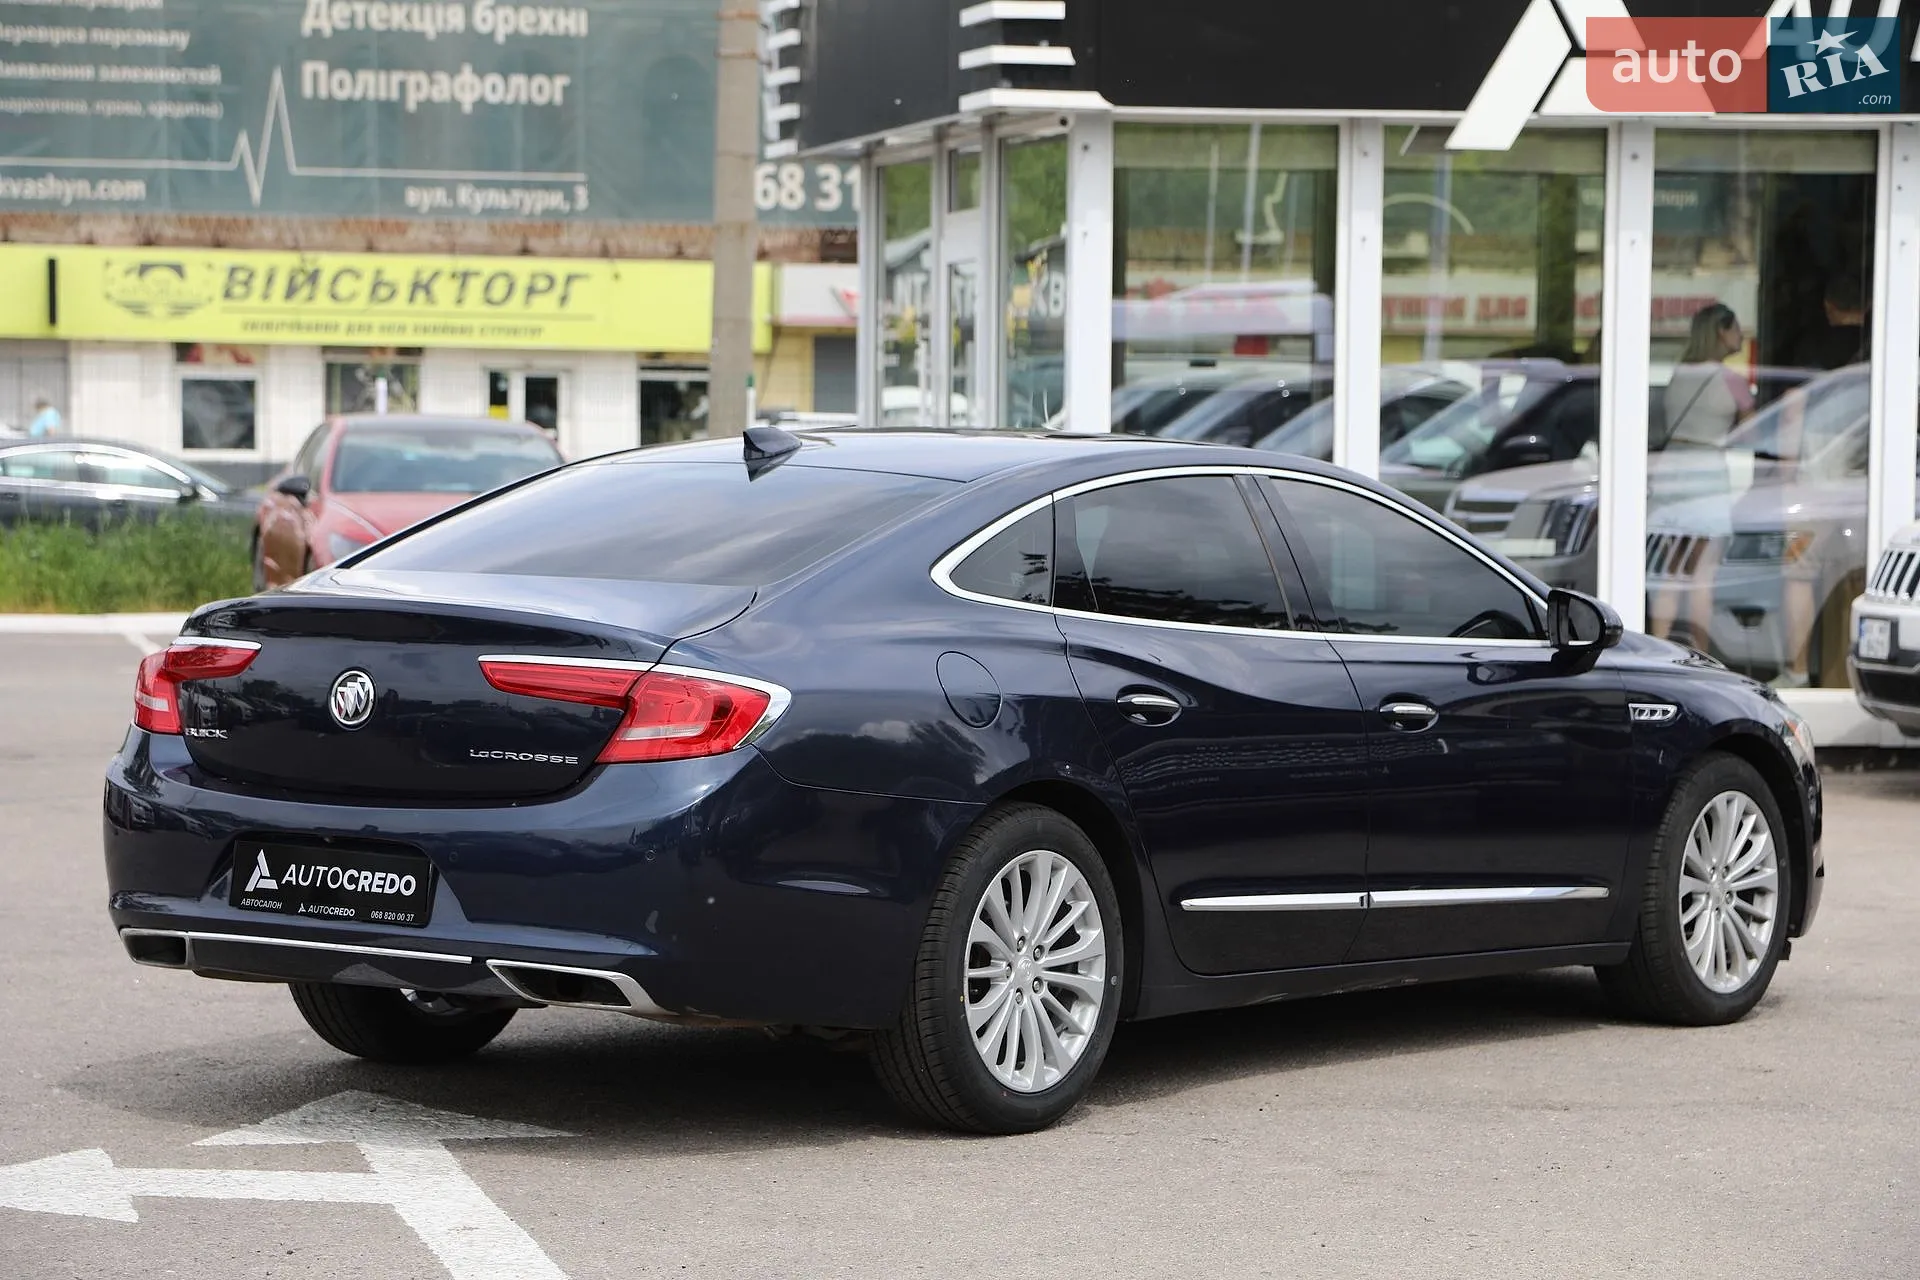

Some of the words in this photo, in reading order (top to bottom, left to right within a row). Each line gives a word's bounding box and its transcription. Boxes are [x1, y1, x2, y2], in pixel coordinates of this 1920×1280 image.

[302, 0, 464, 40] Детекція
[472, 0, 588, 43] брехні
[302, 60, 571, 114] Поліграфолог
[405, 186, 454, 214] вул.
[223, 262, 592, 308] ВІЙСЬКТОРГ
[184, 727, 229, 739] BUICK
[281, 863, 417, 897] AUTOCREDO
[240, 898, 282, 910] АВТОСАЛОН
[307, 905, 356, 917] AUTOCREDO
[370, 910, 383, 920] 068
[384, 912, 396, 921] 820
[397, 913, 406, 922] 00
[406, 914, 415, 922] 37
